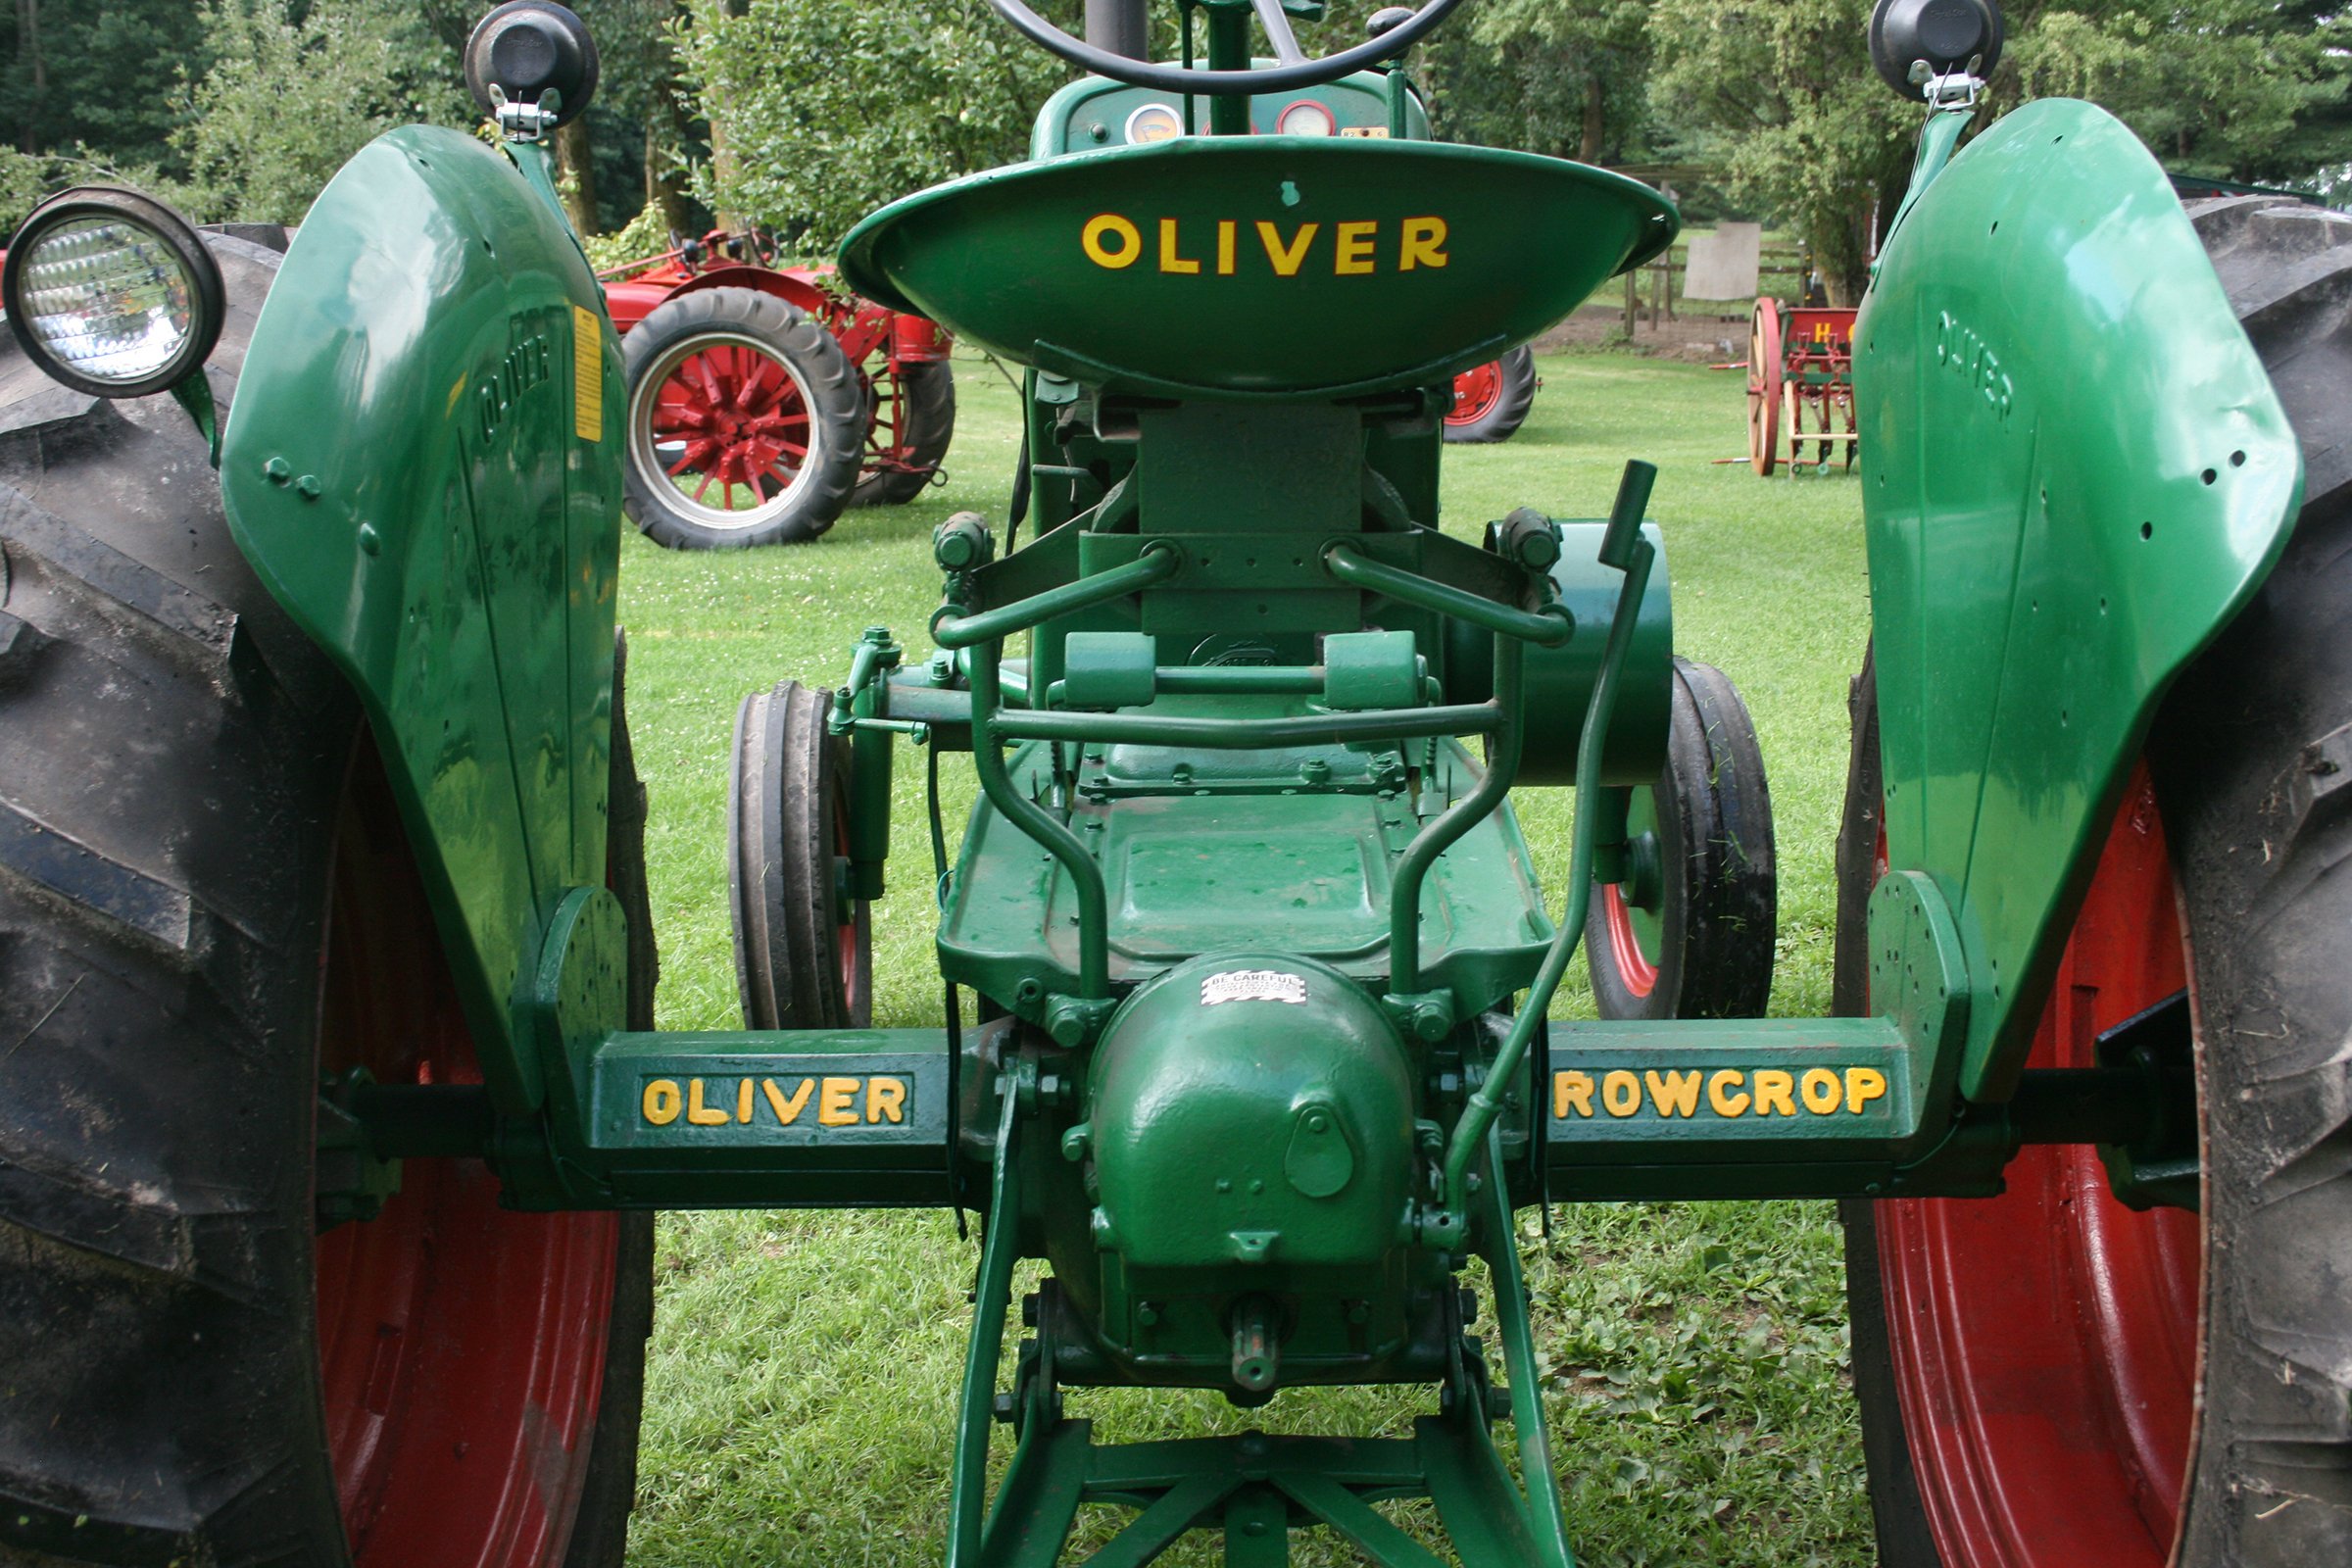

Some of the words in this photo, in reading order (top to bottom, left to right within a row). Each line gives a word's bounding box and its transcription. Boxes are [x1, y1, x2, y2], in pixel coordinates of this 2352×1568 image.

[1081, 212, 1448, 276] OLIVER
[479, 334, 549, 444] OLIVER
[1937, 310, 2013, 432] OLIVER
[1211, 976, 1229, 985] BE
[1233, 974, 1297, 985] CAREFUL
[643, 1077, 906, 1126] OLIVER
[1553, 1067, 1886, 1118] ROWCROP
